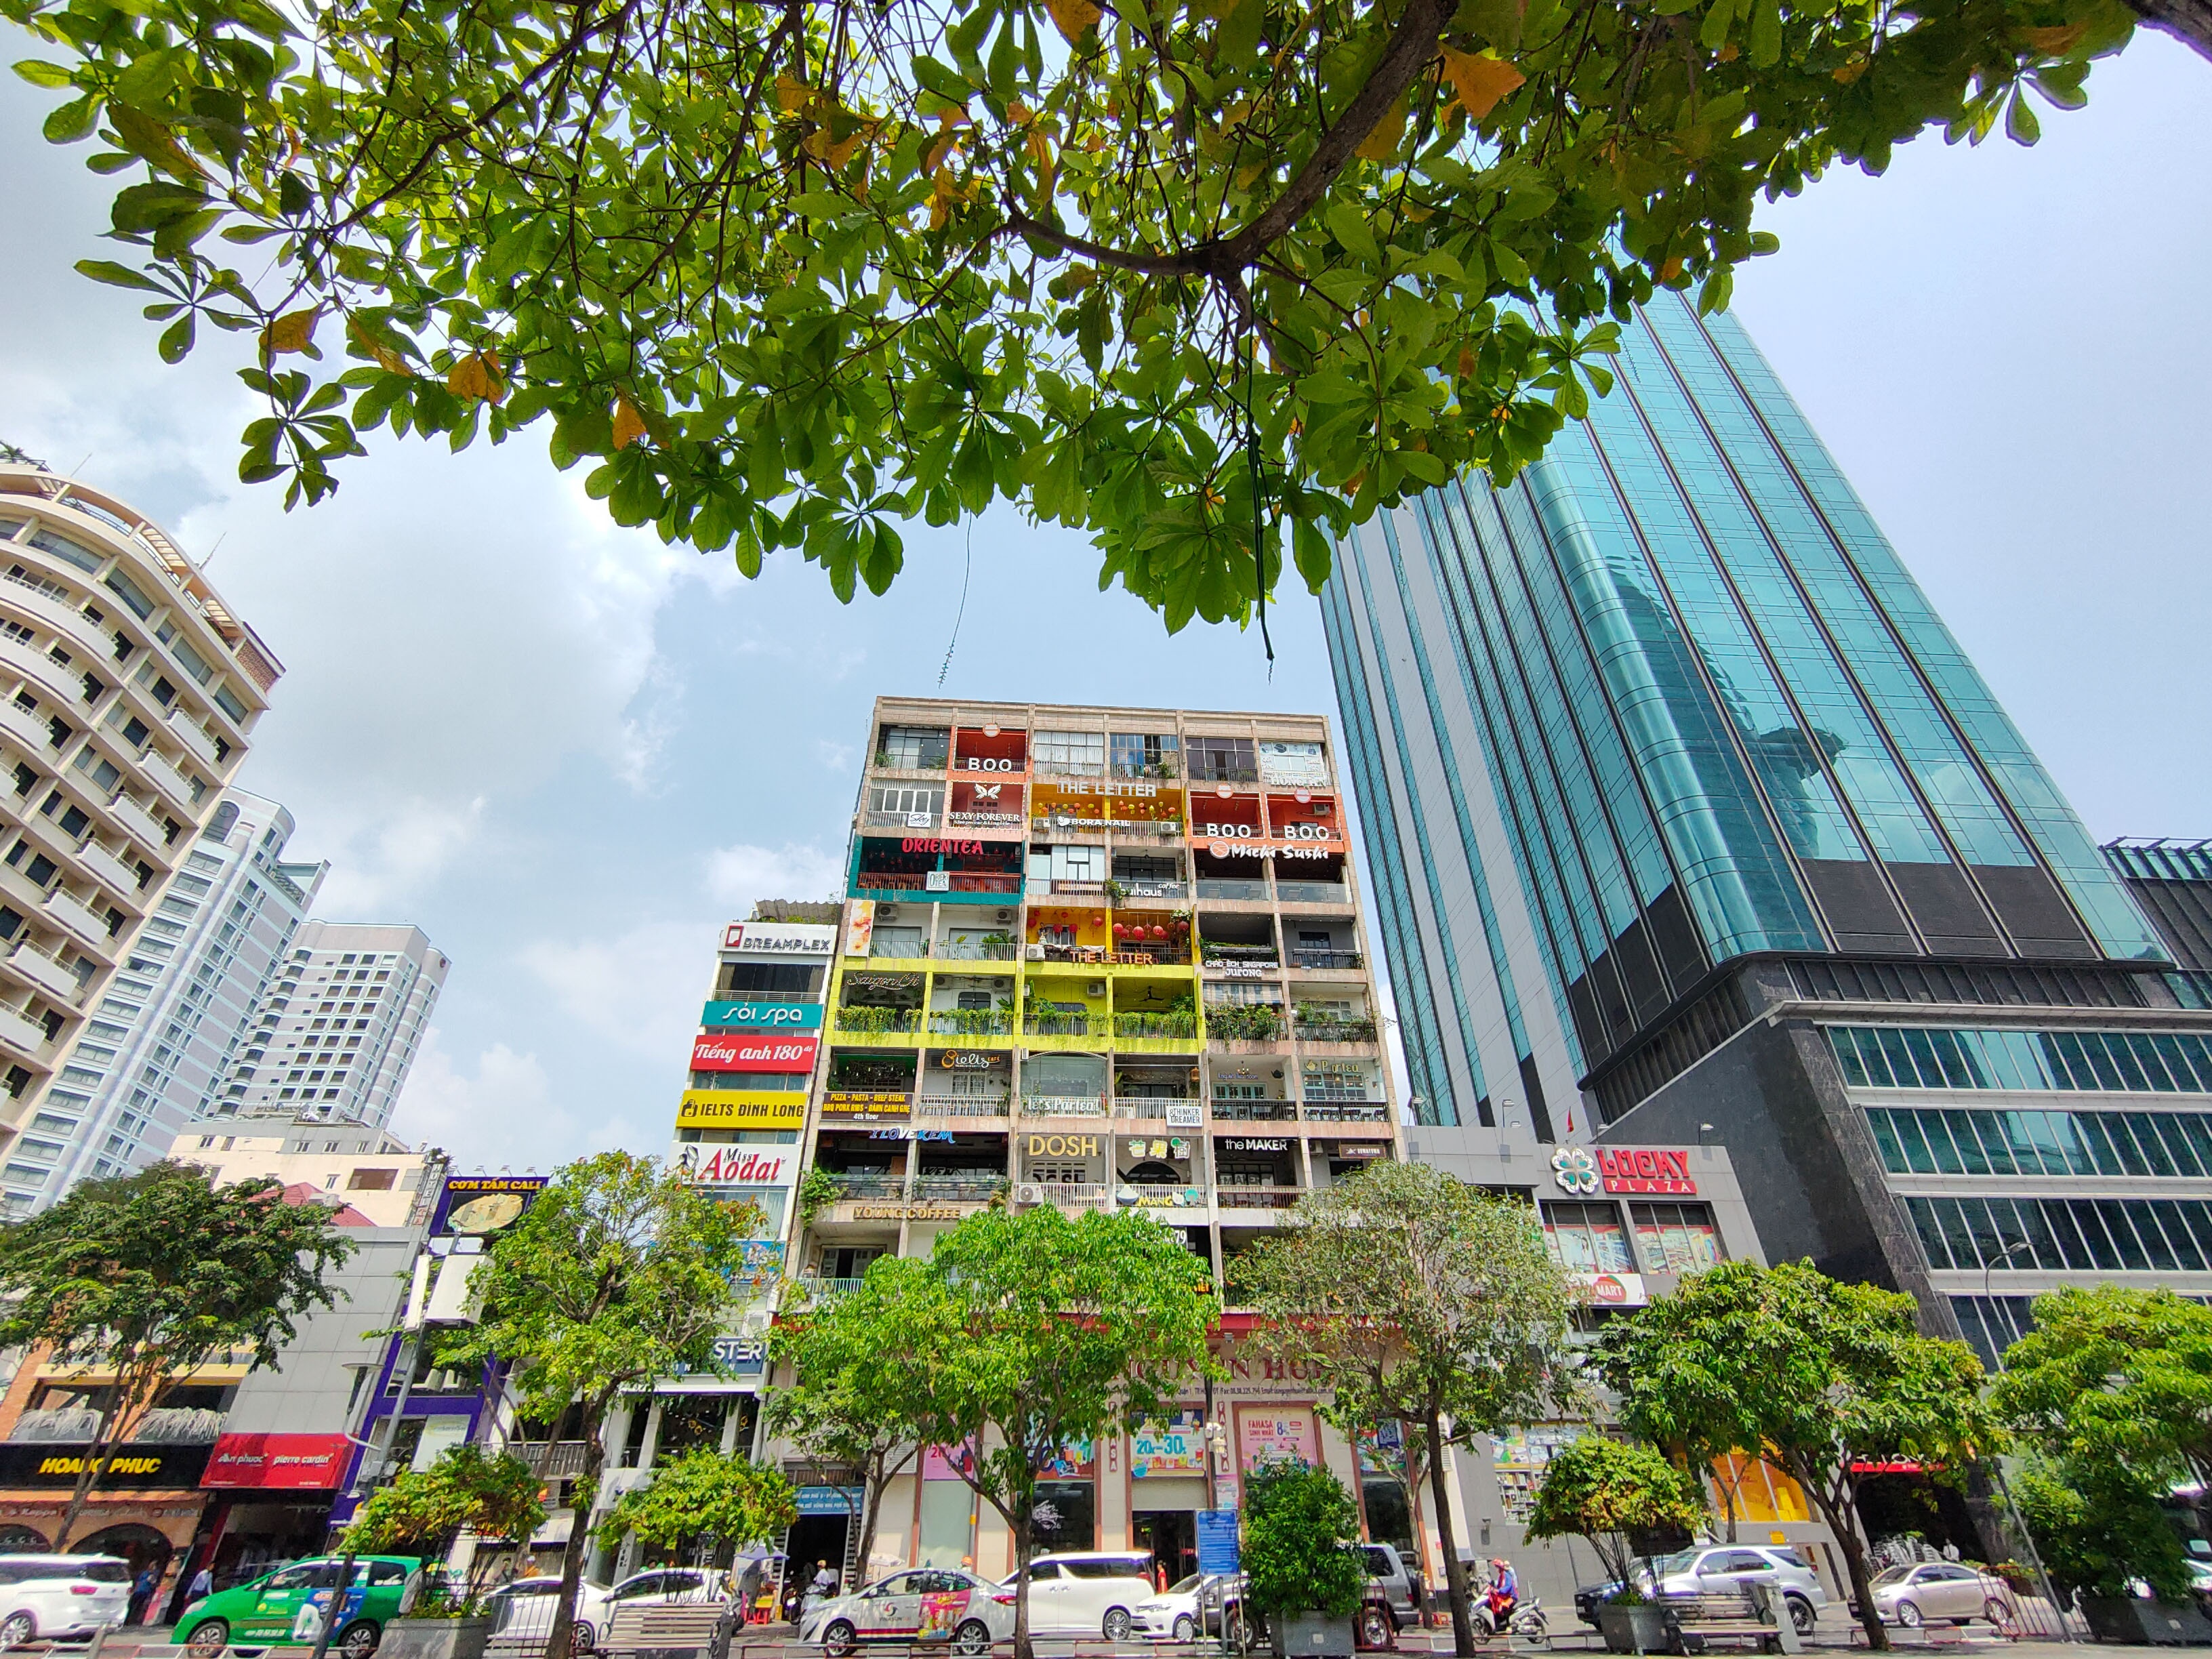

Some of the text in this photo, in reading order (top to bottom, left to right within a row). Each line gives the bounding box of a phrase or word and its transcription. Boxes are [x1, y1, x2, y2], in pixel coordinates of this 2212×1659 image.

[968, 758, 1012, 772] BOO
[1058, 781, 1156, 797] THE LETTER
[910, 813, 929, 825] Sky
[949, 812, 1021, 822] SEXY FOREVER
[1207, 823, 1251, 838] BOO
[1284, 825, 1330, 840] BOO
[902, 838, 983, 854] ORIENTEA
[1231, 843, 1328, 860] Michi Sushi
[743, 937, 830, 950] DREAMPLEX
[1069, 951, 1153, 964] THE LETTER
[761, 1008, 802, 1025] spa
[695, 1042, 736, 1063] Tiếng
[740, 1048, 771, 1061] anh
[773, 1046, 802, 1061] 180
[830, 1093, 846, 1101] PIZZA
[700, 1103, 733, 1116] IELTS
[773, 1104, 804, 1118] LONG
[884, 1105, 899, 1113] CANH
[1174, 1108, 1200, 1116] THINKER
[869, 1126, 956, 1144] I LOVE KEM
[1029, 1135, 1097, 1157] DOSH
[1225, 1139, 1288, 1151] the MAKER
[724, 1148, 753, 1162] Miss
[1595, 1149, 1691, 1177] LUCKY
[448, 1181, 480, 1190] CƠM
[510, 1181, 542, 1190] CALI
[1610, 1181, 1691, 1191] PLAZA
[854, 1207, 961, 1220] YOUNG COFFEE
[1596, 1285, 1622, 1296] MART
[1248, 1420, 1273, 1429] FAHASA
[108, 1458, 161, 1474] PHUC
[273, 1454, 329, 1465] pierre cardin
